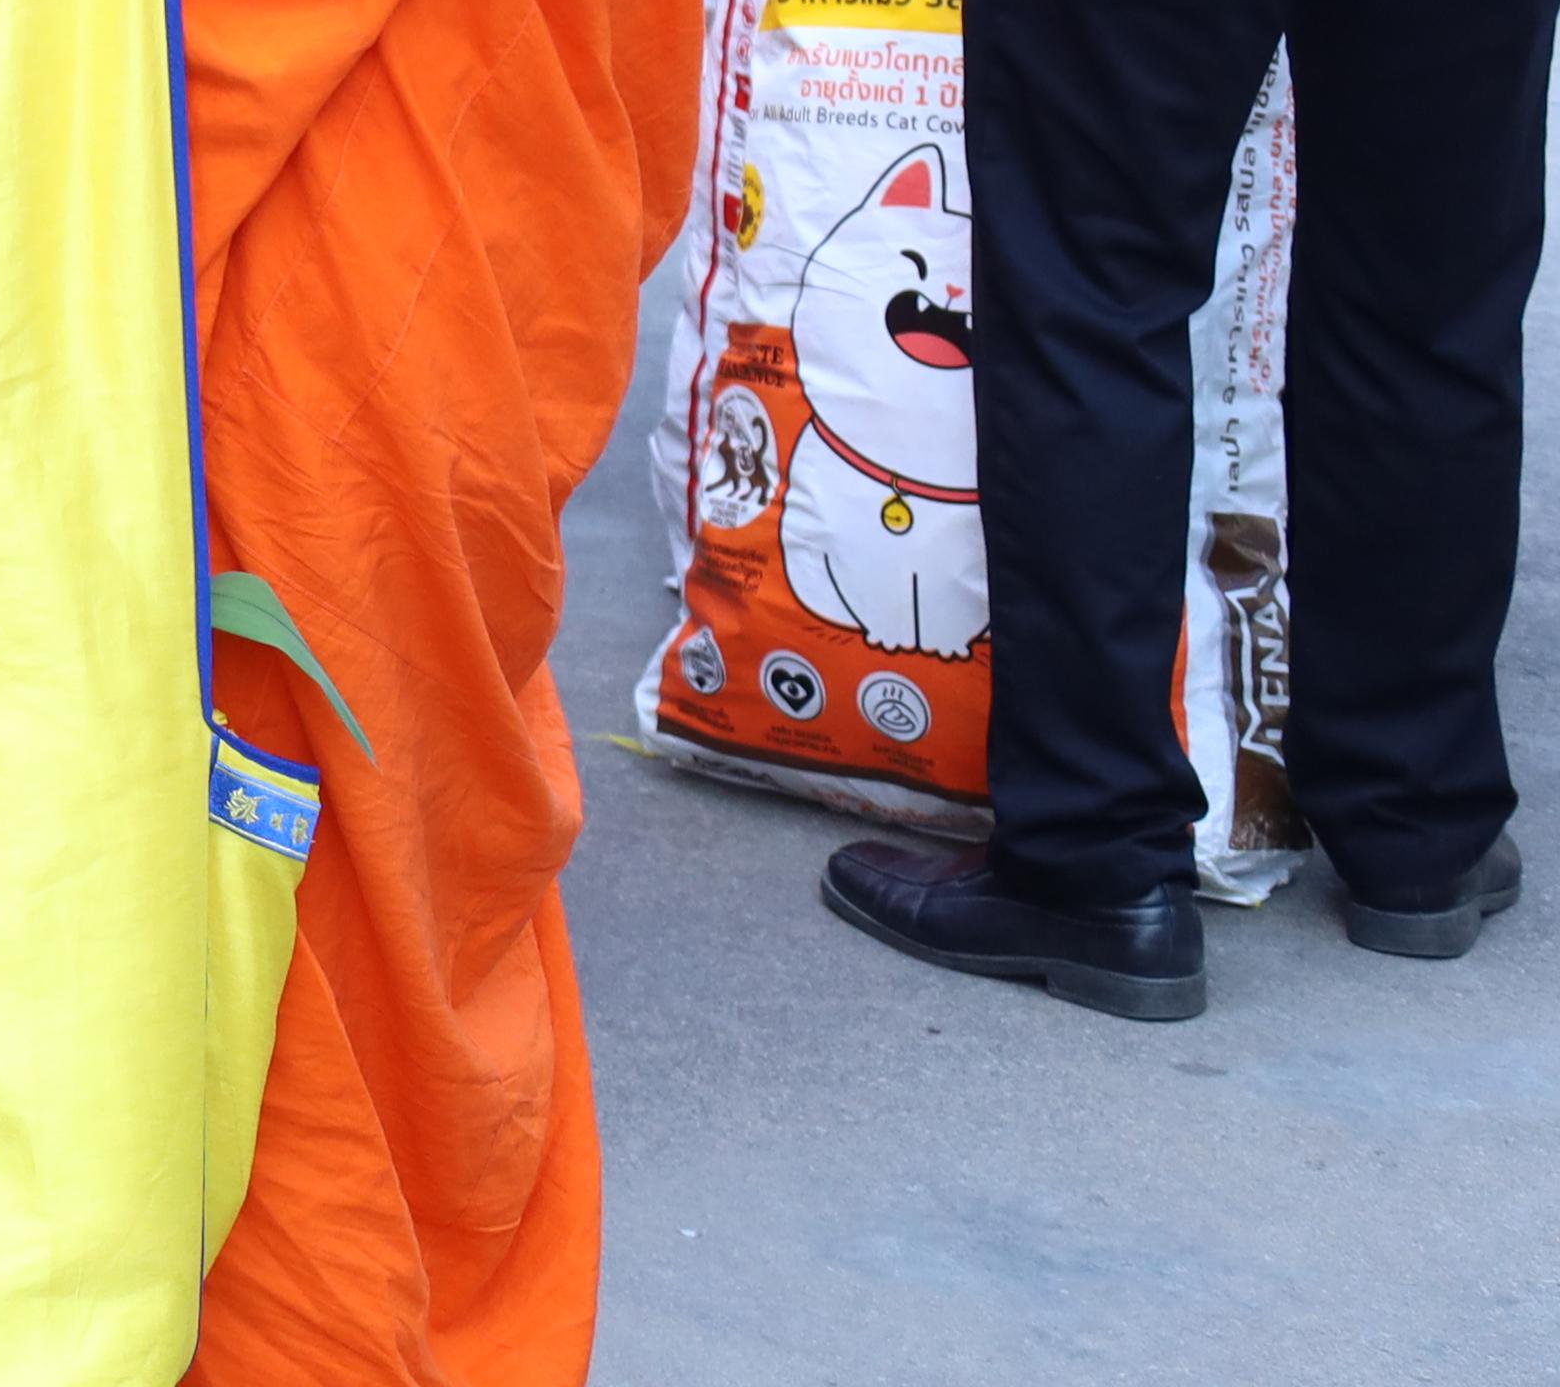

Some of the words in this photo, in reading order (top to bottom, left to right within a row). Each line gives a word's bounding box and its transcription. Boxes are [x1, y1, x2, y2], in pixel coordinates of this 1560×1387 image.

[800, 69, 904, 107] อายุตั้งแต่
[915, 86, 929, 106] 1
[816, 108, 880, 128] Breeds
[886, 112, 918, 131] Cat
